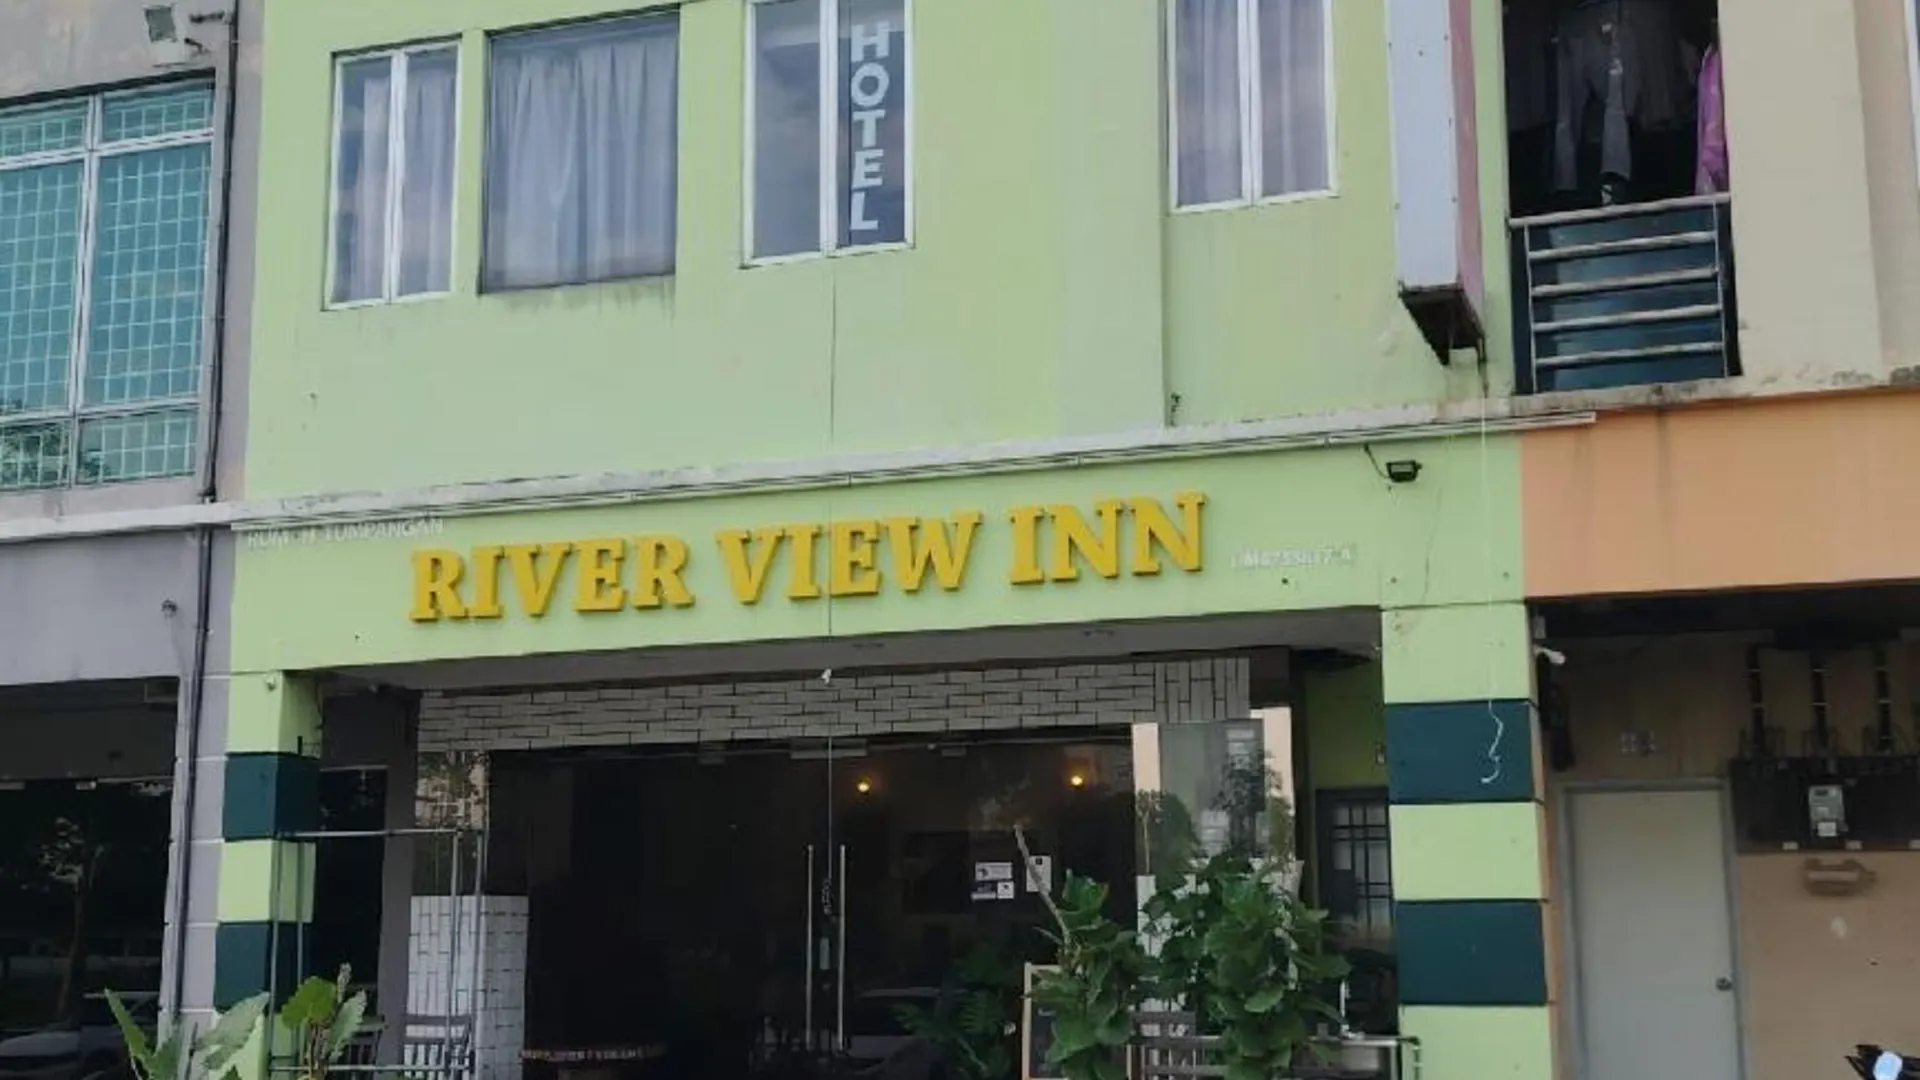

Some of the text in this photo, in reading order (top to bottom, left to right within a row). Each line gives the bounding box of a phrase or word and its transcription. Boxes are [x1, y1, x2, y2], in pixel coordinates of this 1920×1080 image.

[850, 20, 890, 231] HOTEL
[410, 490, 1208, 624] RIVER VIEW INN
